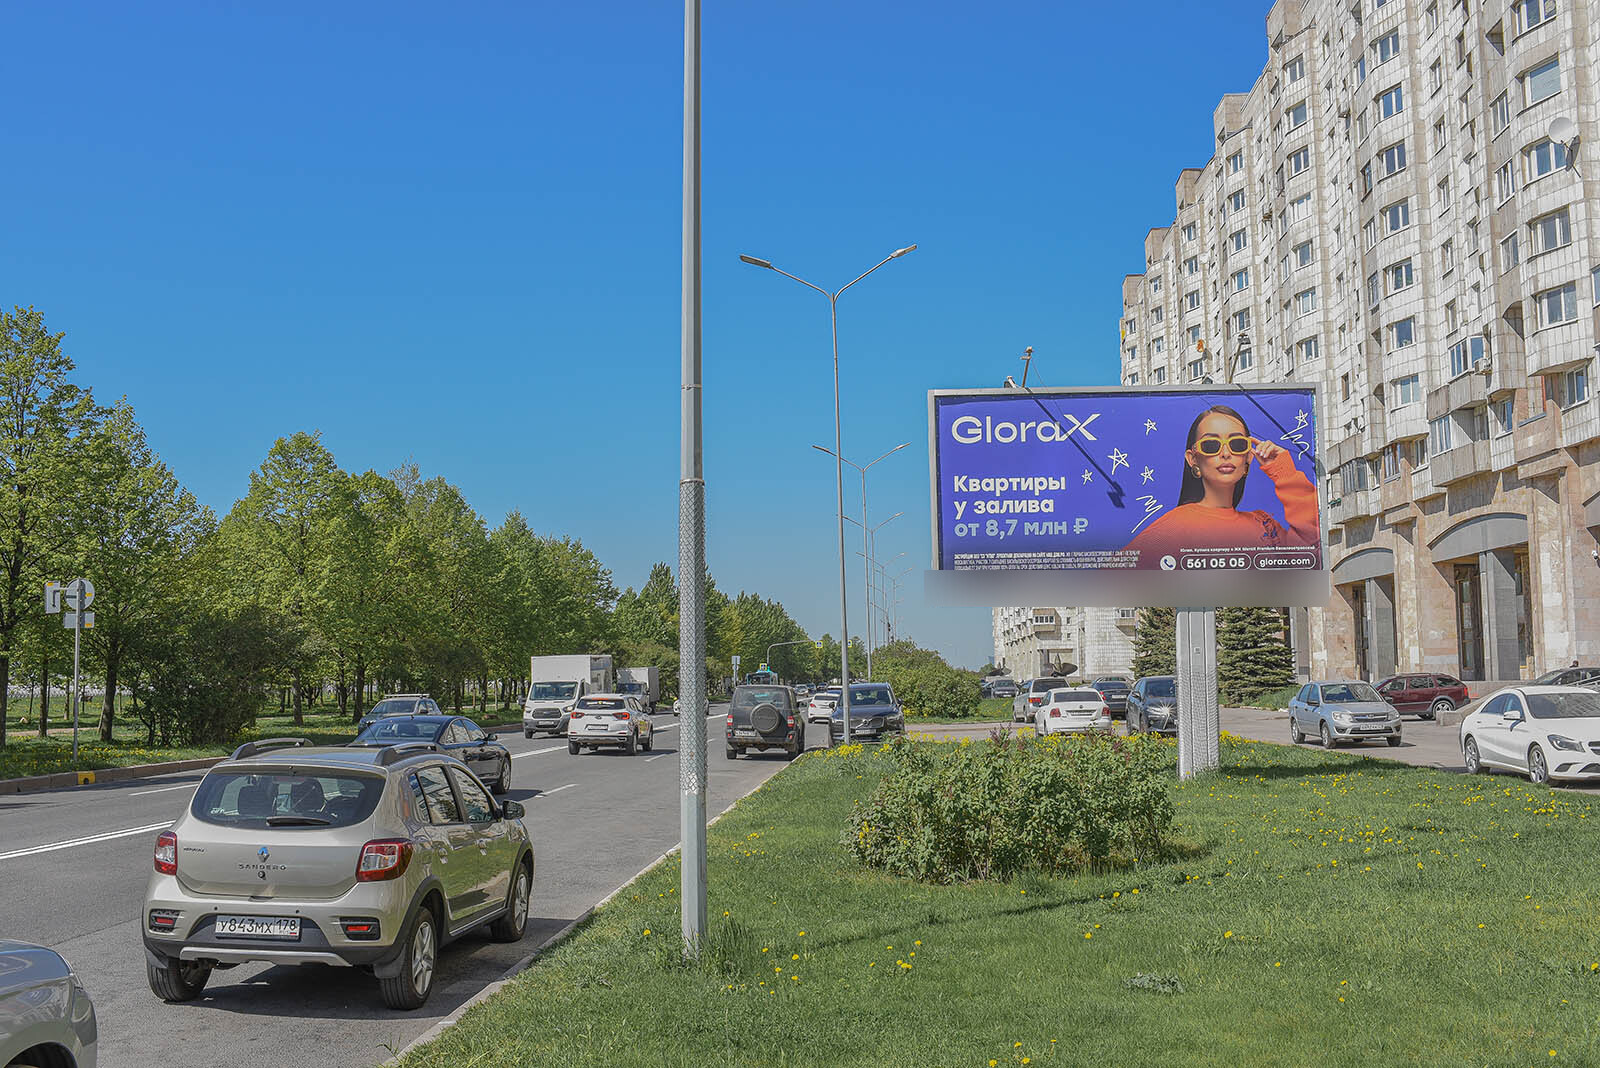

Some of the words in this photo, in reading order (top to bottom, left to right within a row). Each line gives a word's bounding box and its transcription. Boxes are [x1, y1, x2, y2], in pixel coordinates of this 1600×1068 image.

[952, 413, 1102, 444] GloraX
[953, 475, 1066, 497] Квартиры
[953, 500, 967, 520] у
[973, 499, 1054, 514] залива
[954, 523, 980, 537] от
[985, 519, 1018, 540] 8,7
[1024, 521, 1067, 536] млн
[1186, 559, 1206, 569] 561
[1210, 558, 1225, 568] 05
[1229, 557, 1245, 568] 05
[1259, 556, 1311, 567] glorax.com
[276, 919, 297, 931] 178
